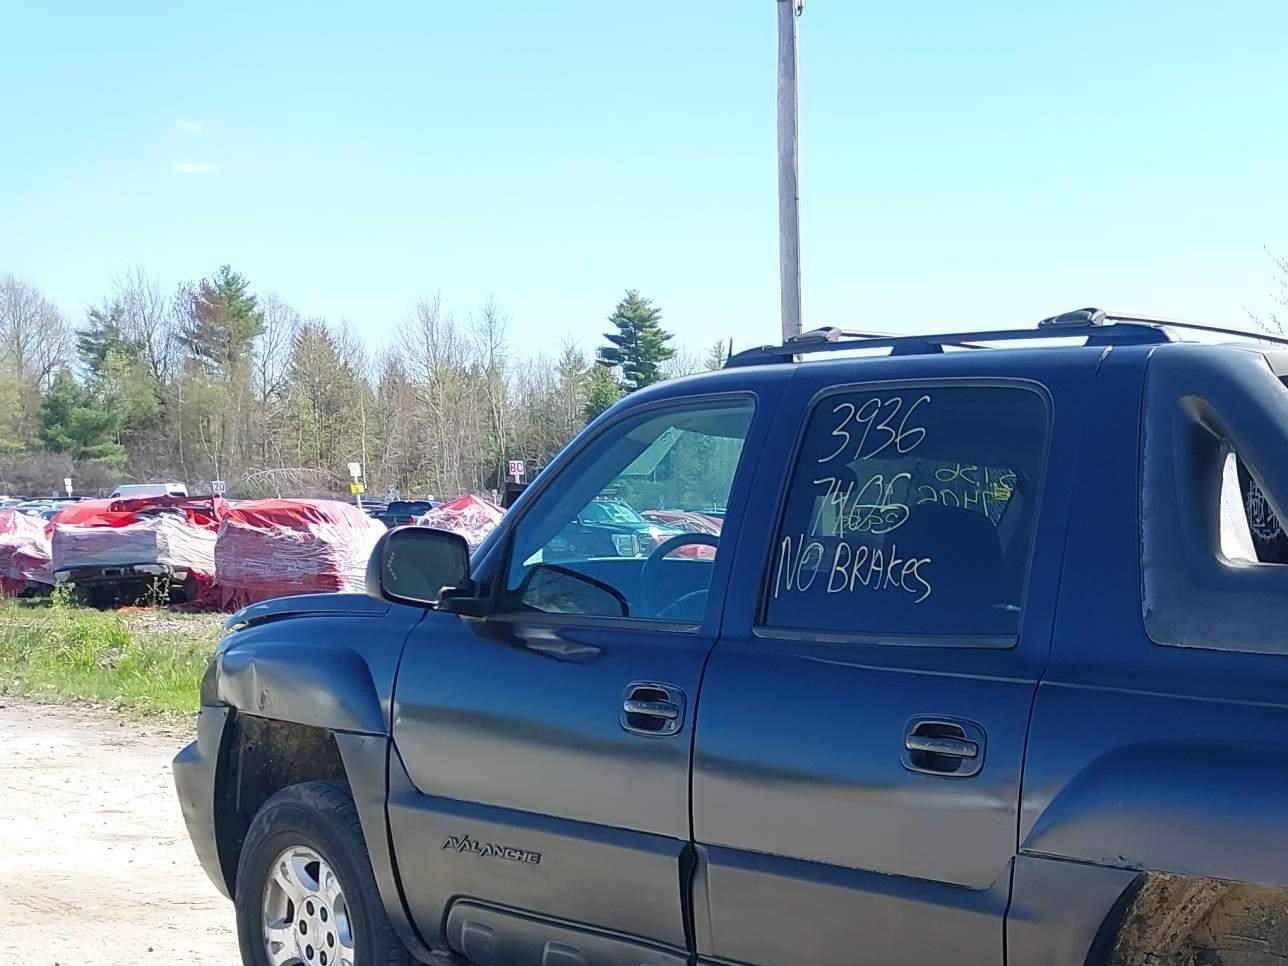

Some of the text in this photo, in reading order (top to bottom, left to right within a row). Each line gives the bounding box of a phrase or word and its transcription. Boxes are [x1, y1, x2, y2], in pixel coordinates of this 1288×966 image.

[817, 395, 931, 463] 3936
[774, 533, 824, 599] NO
[439, 834, 542, 865] AVALANCHE
